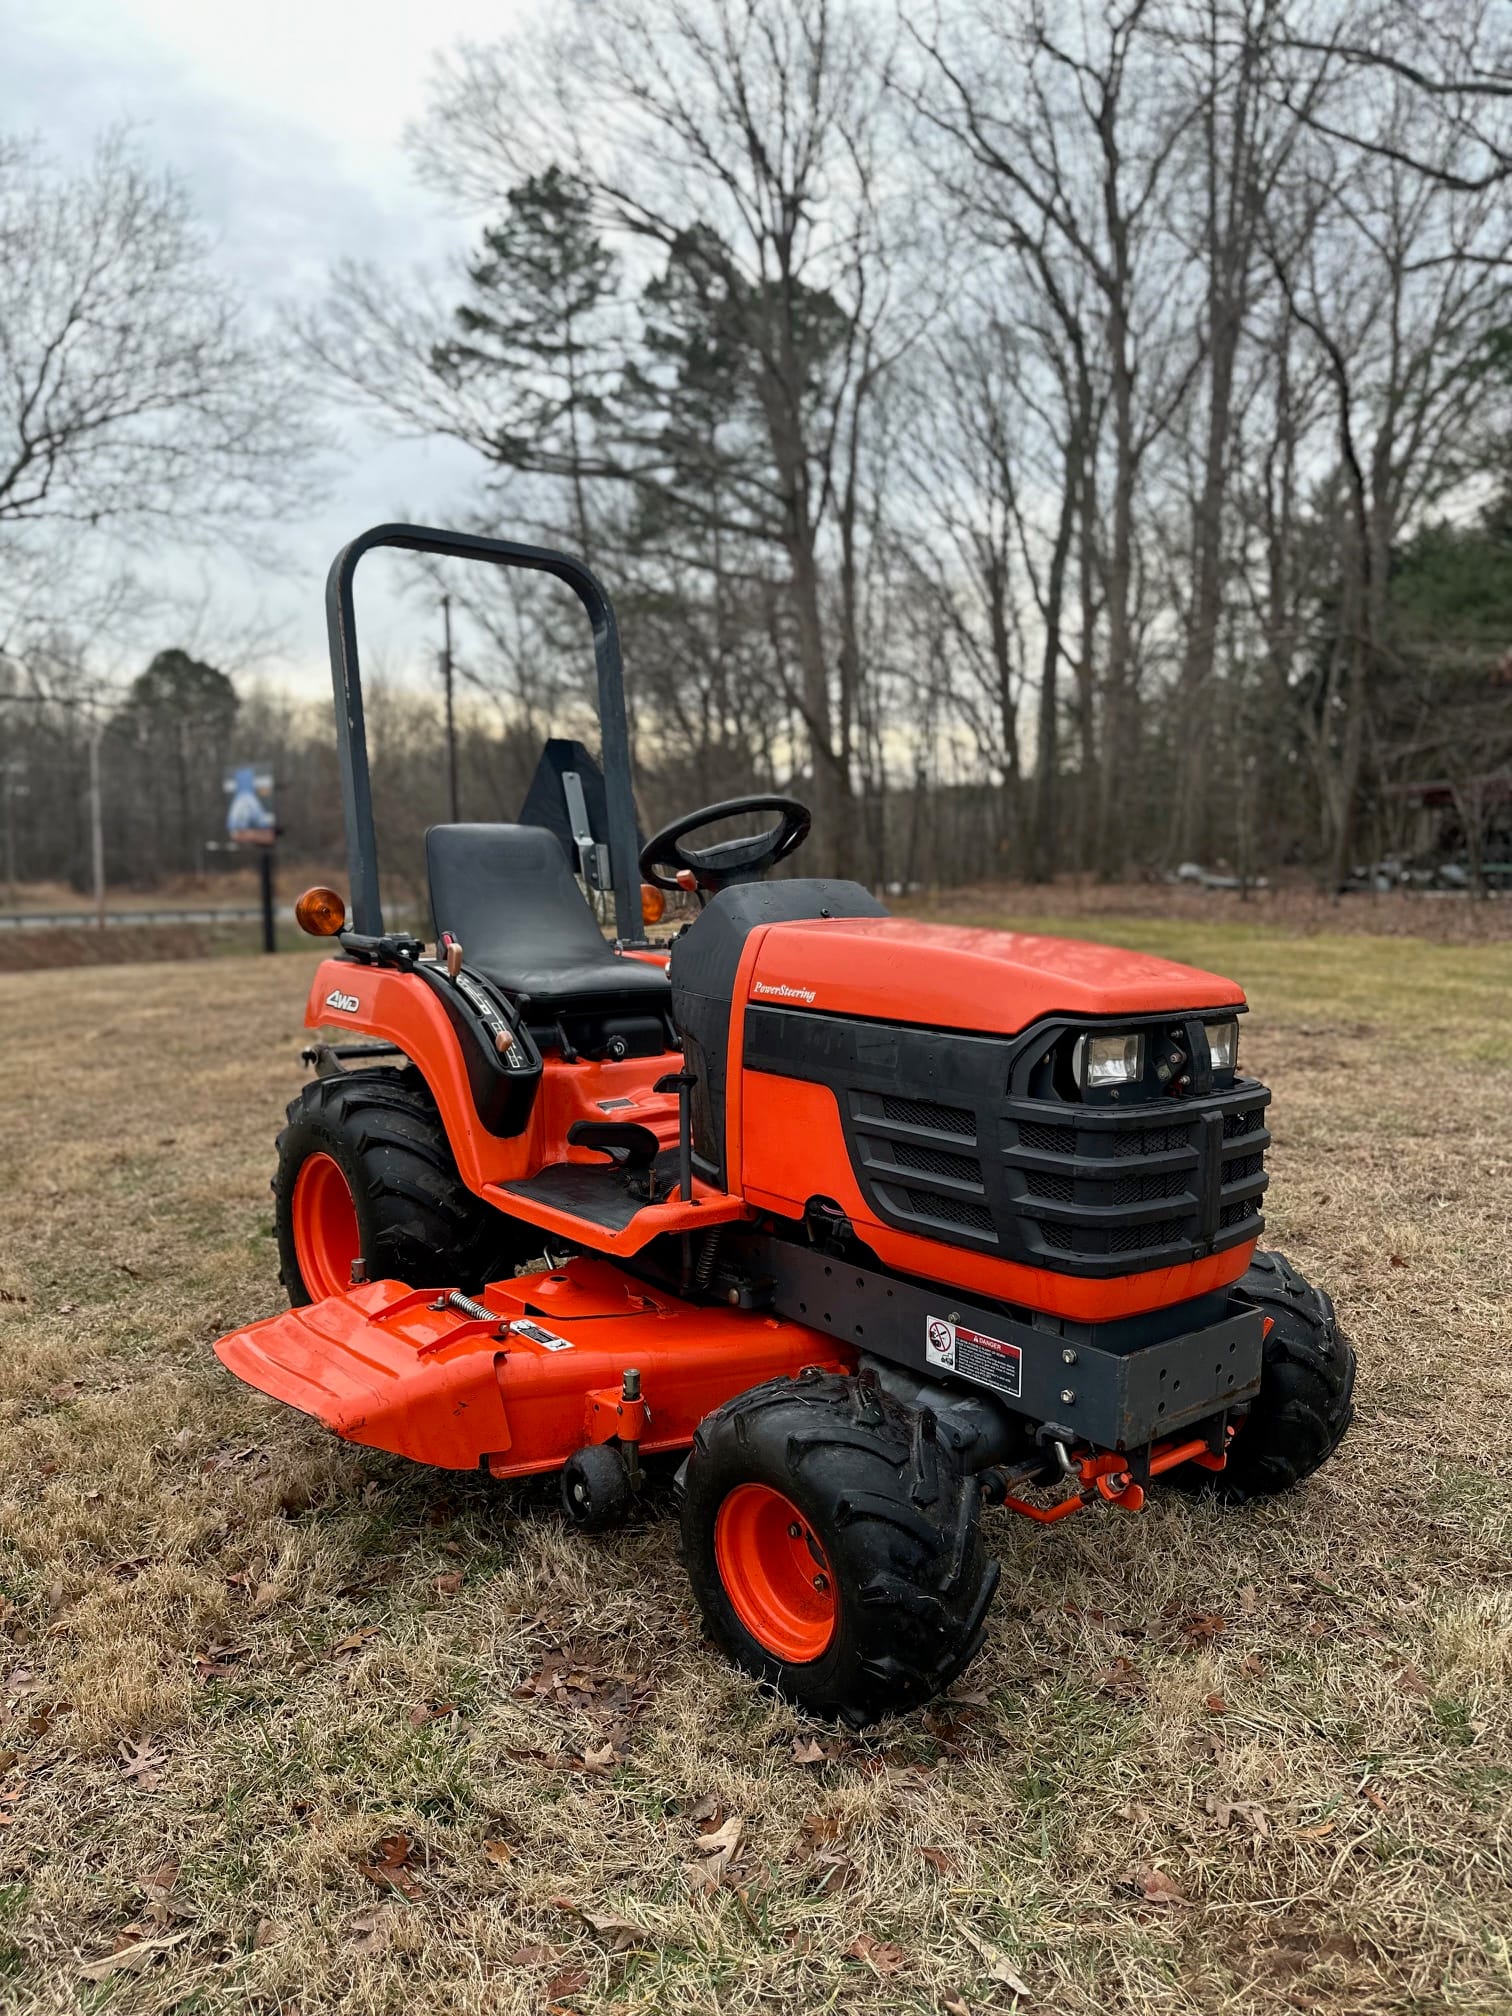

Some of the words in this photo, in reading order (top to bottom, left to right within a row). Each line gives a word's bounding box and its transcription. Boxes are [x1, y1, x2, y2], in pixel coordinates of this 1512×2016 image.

[326, 990, 360, 1012] 4WD
[754, 981, 817, 1003] PowerSteering
[979, 1336, 1002, 1351] DANGER
